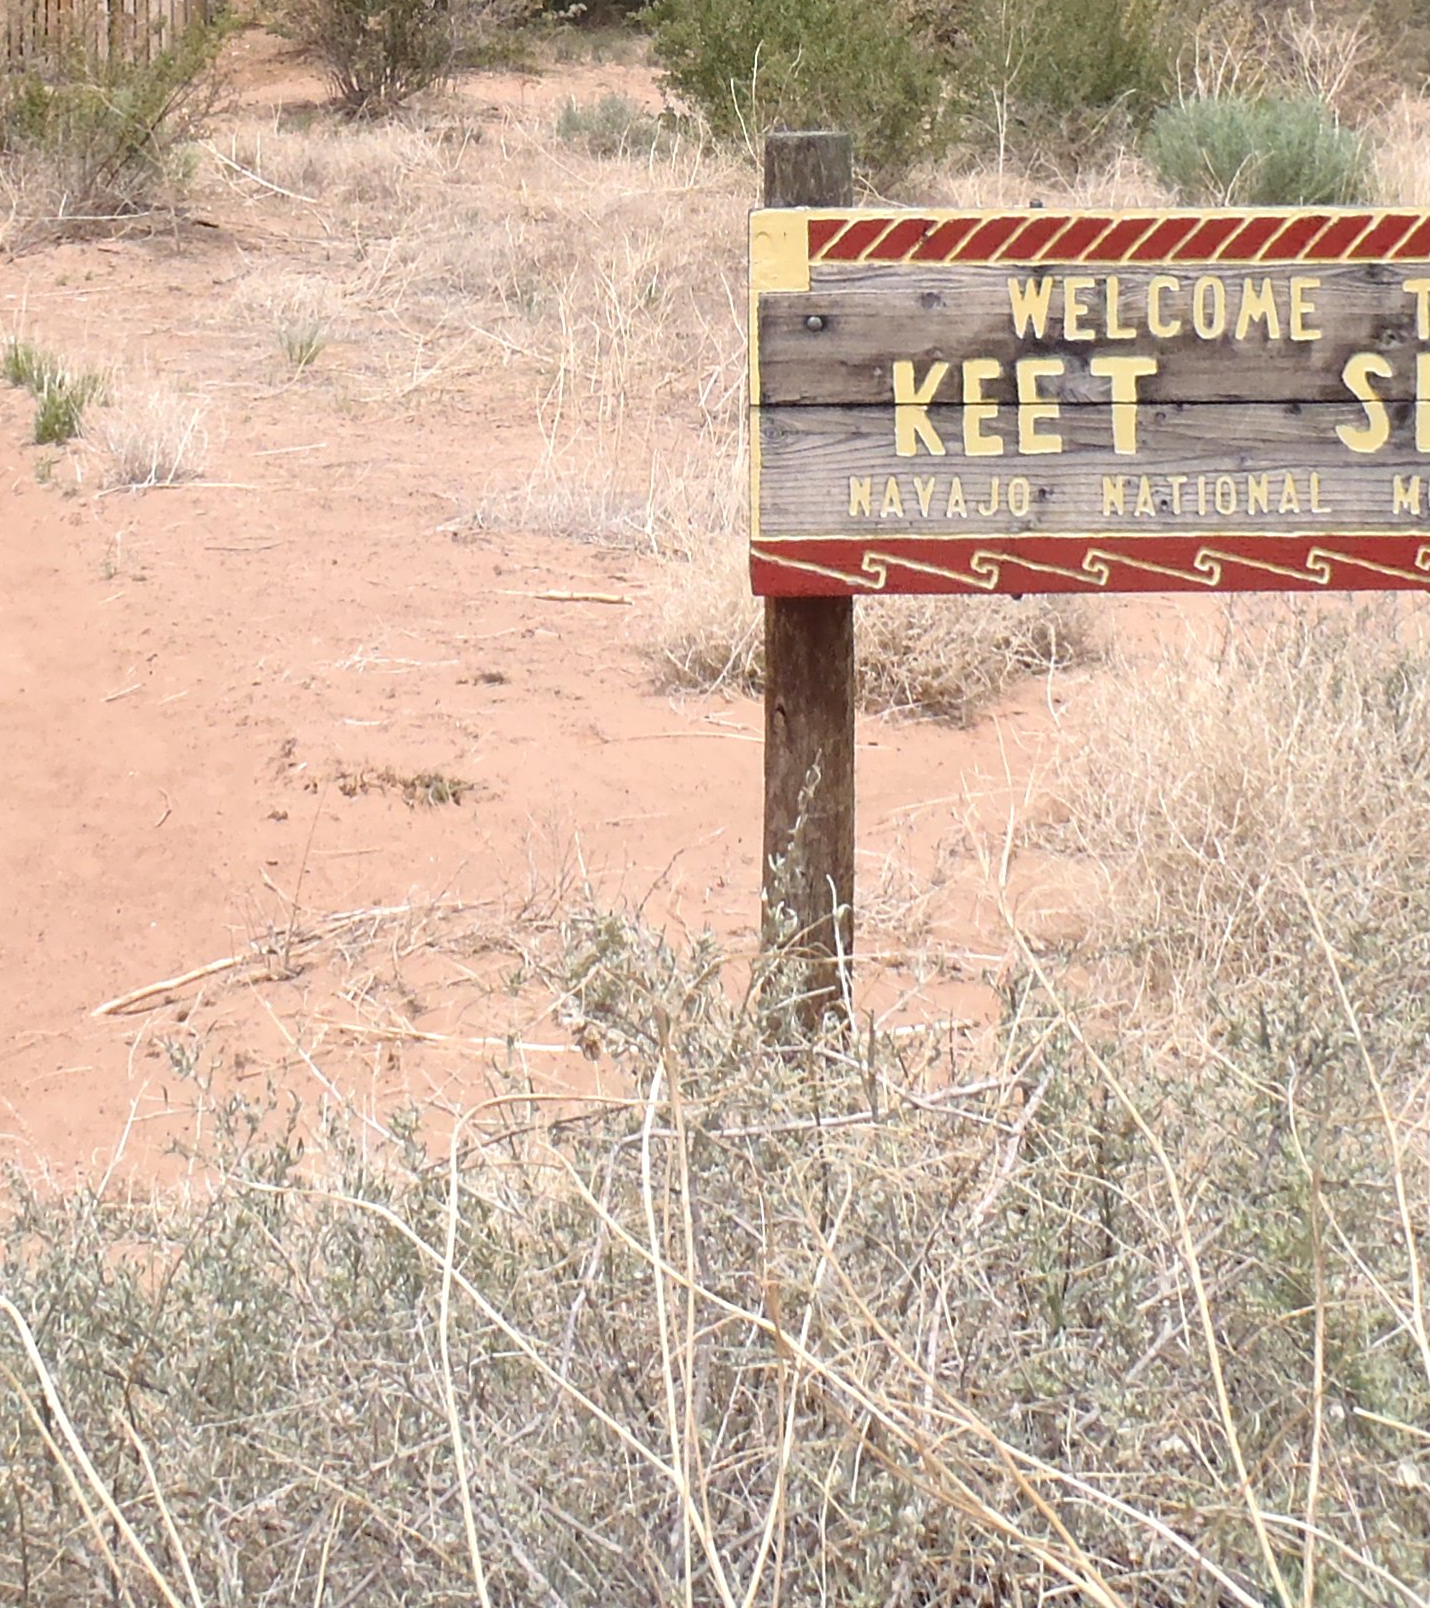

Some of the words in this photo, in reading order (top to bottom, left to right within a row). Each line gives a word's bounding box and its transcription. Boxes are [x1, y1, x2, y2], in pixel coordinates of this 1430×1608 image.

[1008, 276, 1322, 341] WELCOME
[892, 356, 1157, 457] KEET
[848, 476, 1032, 518] NAVAJO
[1102, 473, 1333, 516] NATIONAL
